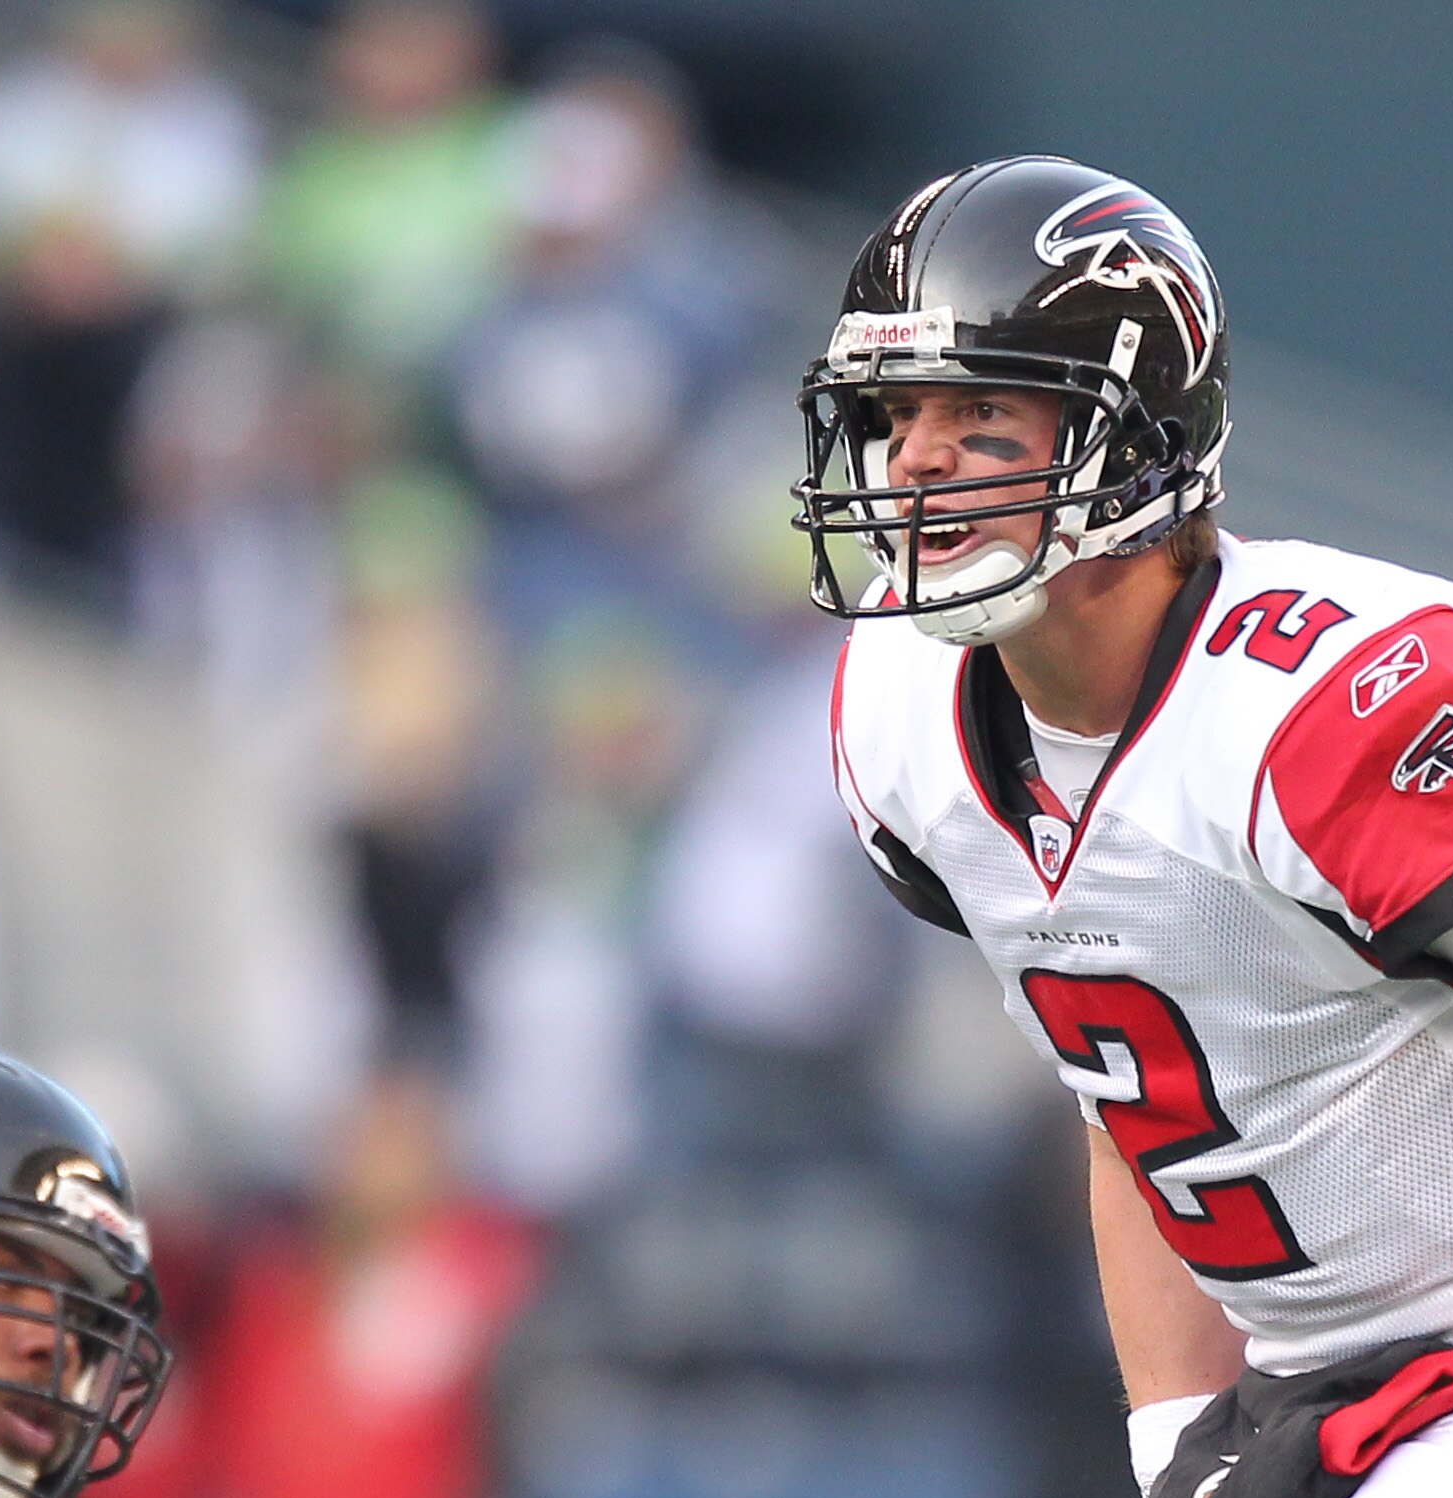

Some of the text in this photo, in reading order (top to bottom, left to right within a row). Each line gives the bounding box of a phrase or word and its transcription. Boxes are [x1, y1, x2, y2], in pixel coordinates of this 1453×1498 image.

[863, 324, 930, 344] Riddel
[1205, 589, 1357, 674] 2
[1026, 931, 1120, 947] FALCONS
[1019, 966, 1316, 1282] 2
